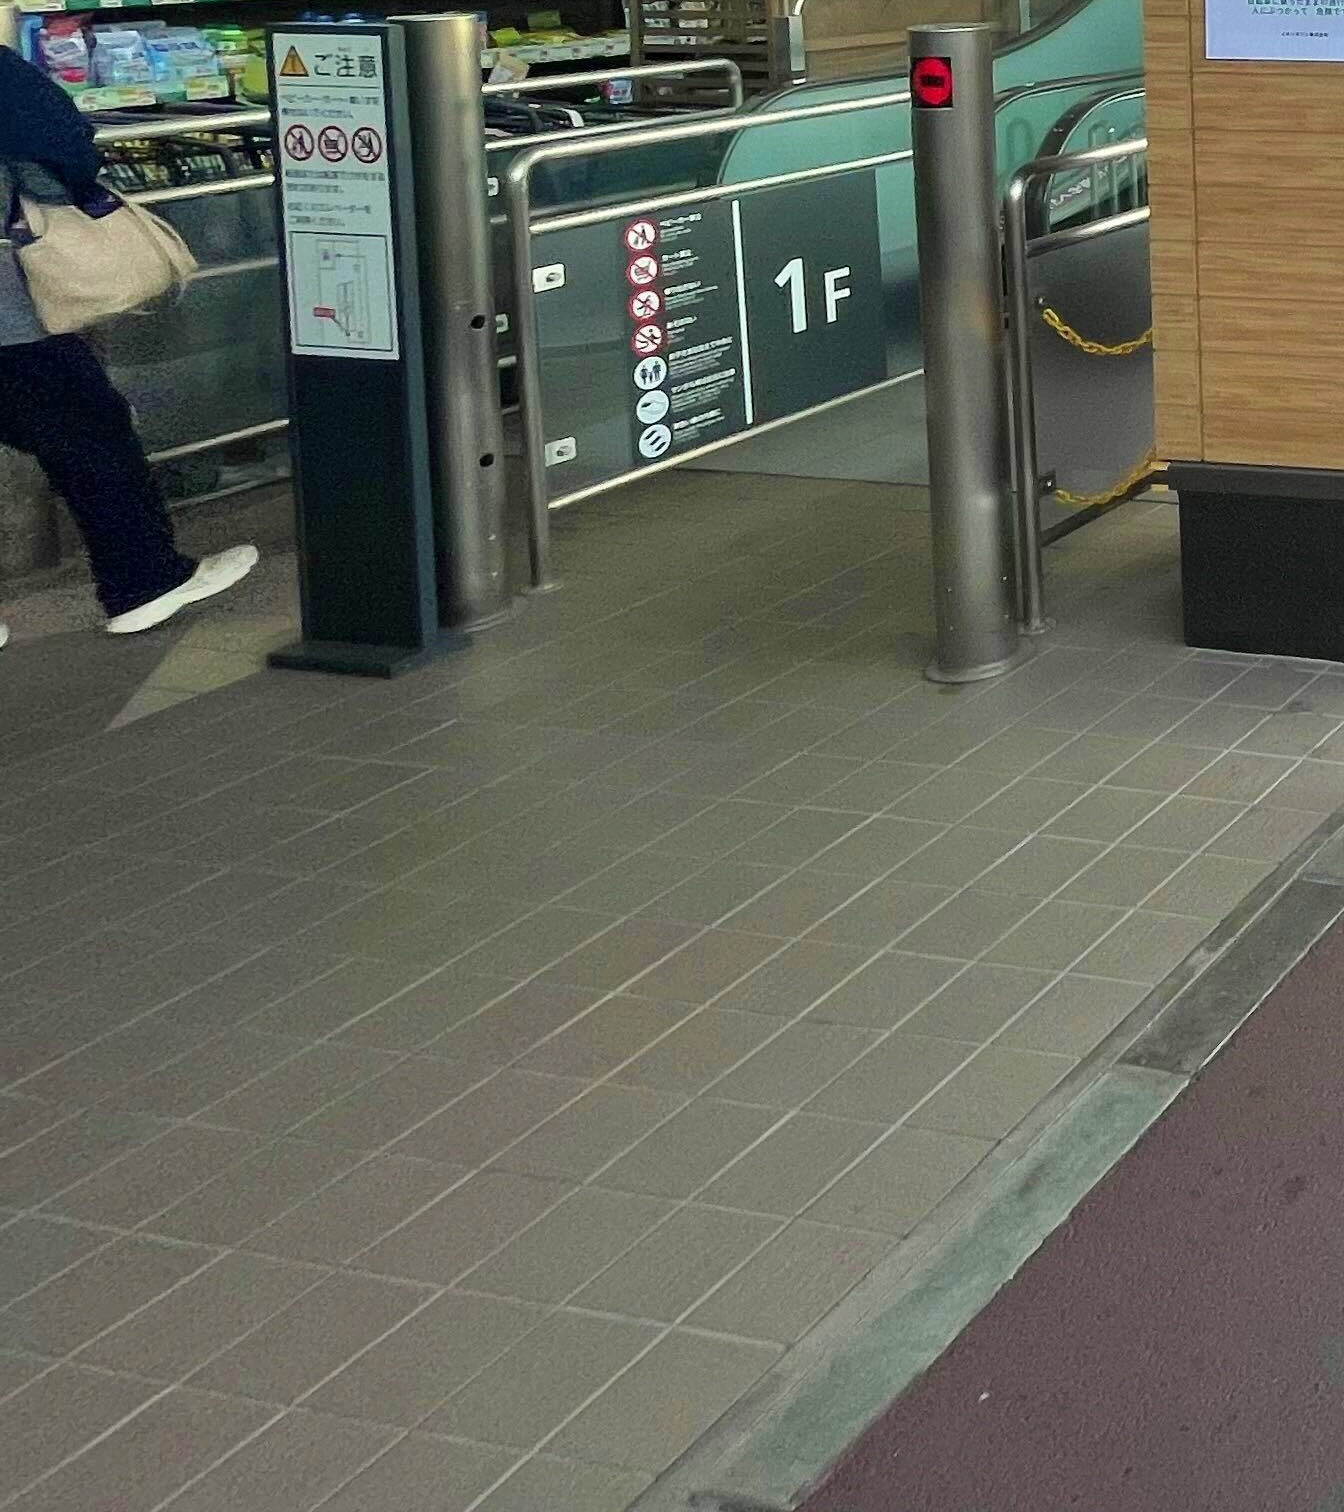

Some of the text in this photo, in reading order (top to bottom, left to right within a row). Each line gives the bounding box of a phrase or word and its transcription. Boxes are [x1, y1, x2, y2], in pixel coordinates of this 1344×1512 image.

[314, 53, 377, 78] ご注意
[774, 257, 852, 335] 1F
